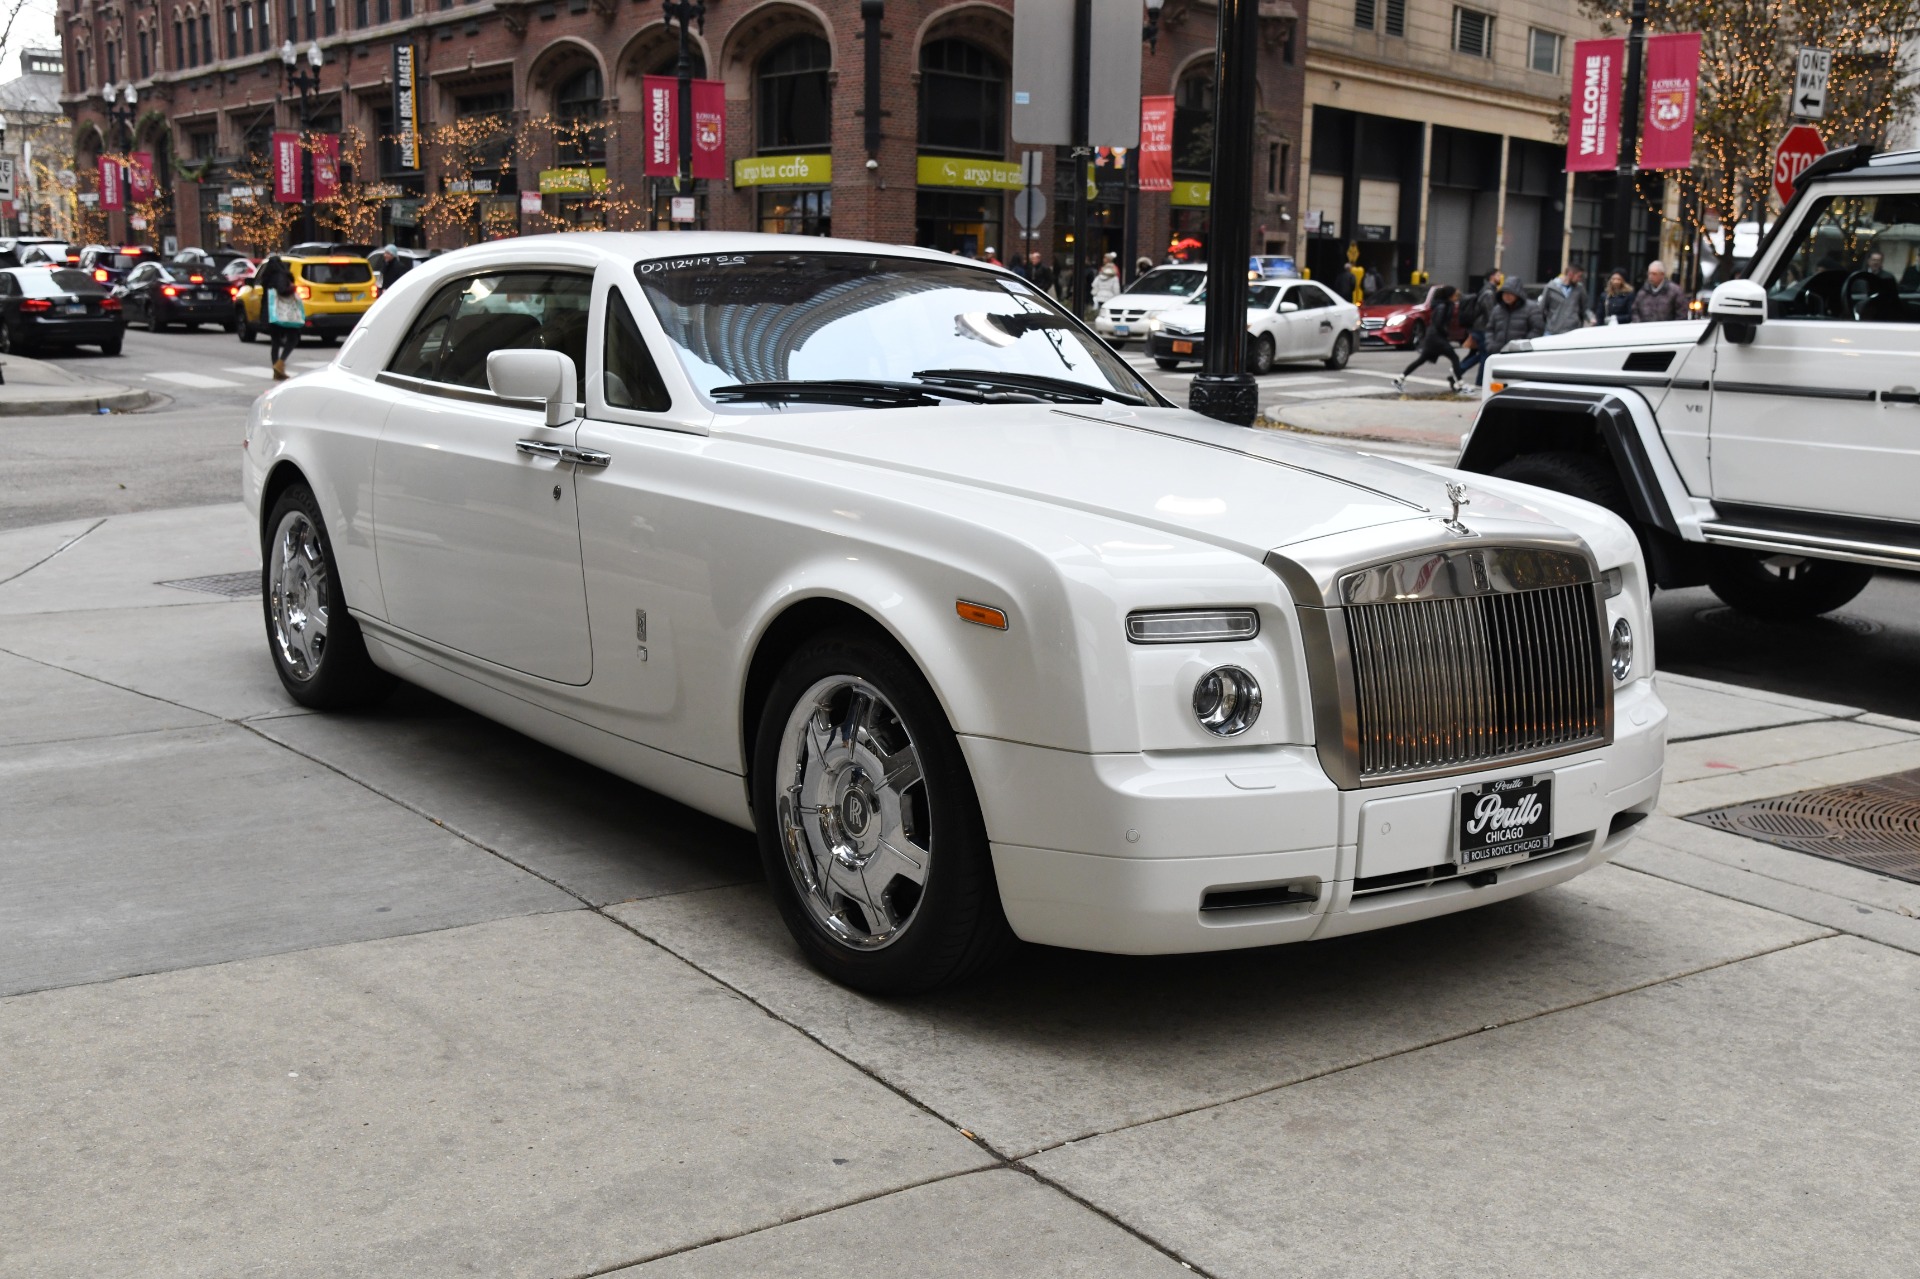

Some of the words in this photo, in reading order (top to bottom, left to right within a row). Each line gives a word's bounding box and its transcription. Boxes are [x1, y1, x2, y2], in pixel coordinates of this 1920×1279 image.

[397, 46, 412, 87] BAGELS
[1601, 55, 1611, 93] CAMPUS
[1802, 53, 1827, 72] ONE
[1652, 78, 1691, 89] LOYOLA
[1800, 73, 1825, 91] WAY
[1580, 55, 1602, 156] WELCOME
[1599, 93, 1608, 126] TOWER
[652, 88, 665, 164] WELCOME
[1596, 128, 1606, 155] WATER
[280, 142, 291, 194] WELCOME
[761, 164, 776, 179] tea
[779, 157, 809, 178] café
[964, 169, 991, 186] argo
[992, 168, 1007, 183] tea
[1776, 151, 1823, 184] STO
[1492, 779, 1524, 792] Perillo
[1467, 793, 1543, 834] Perillo
[1485, 827, 1524, 843] CHICAGO
[1471, 848, 1491, 860] ROLLS
[1491, 844, 1512, 857] ROYCE
[1513, 839, 1541, 853] CHICAGO
